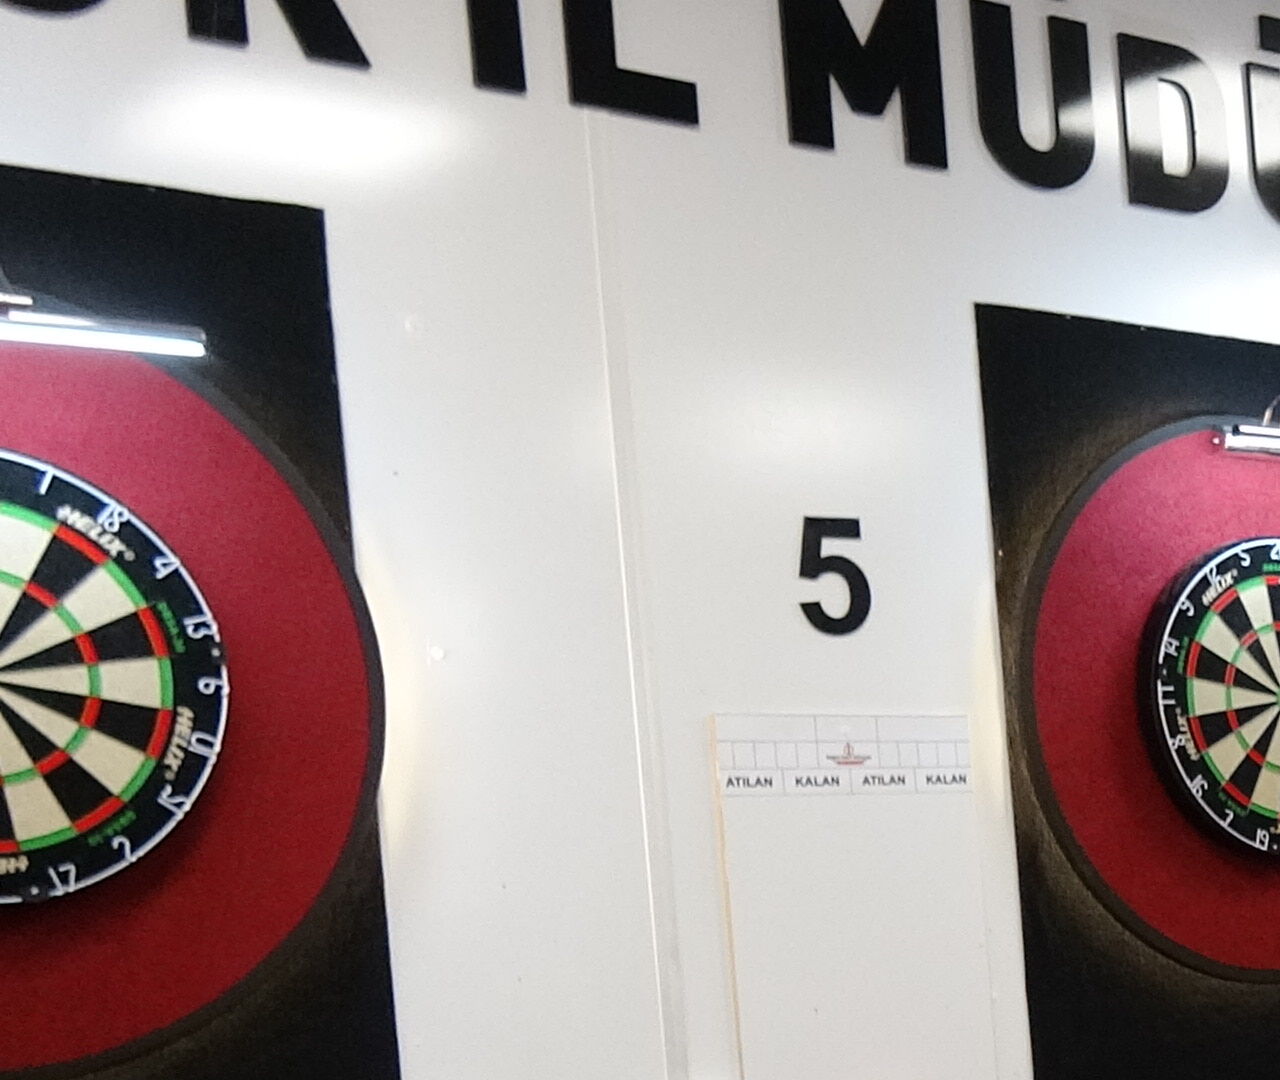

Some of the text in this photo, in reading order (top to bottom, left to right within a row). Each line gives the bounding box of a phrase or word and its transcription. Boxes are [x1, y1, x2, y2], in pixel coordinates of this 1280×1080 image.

[97, 502, 129, 533] 18
[798, 516, 872, 636] 5
[183, 614, 217, 640] 13
[726, 773, 967, 789] ATILAN KALAN ATILAN KALAN
[48, 862, 77, 895] 17
